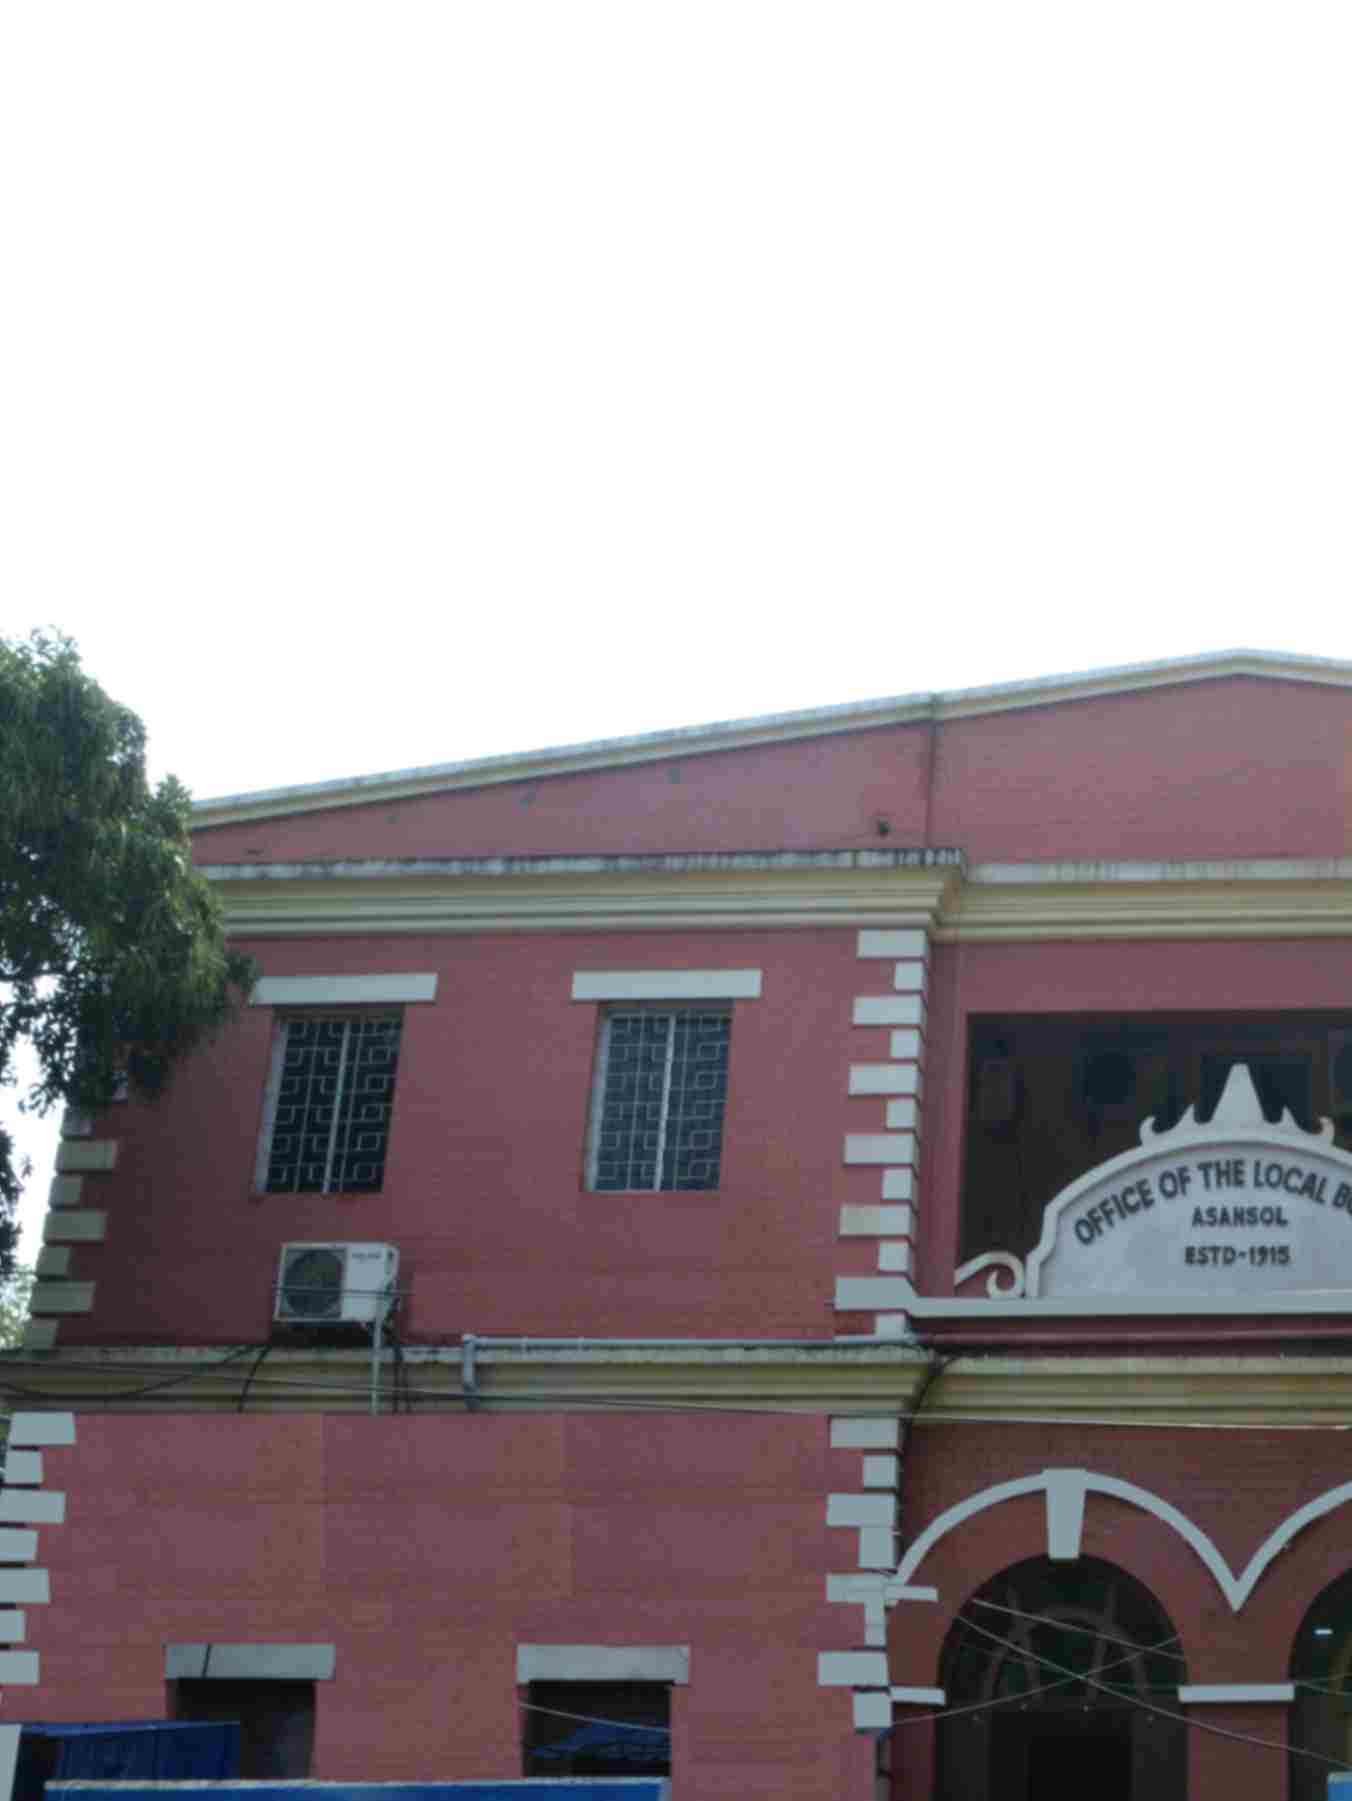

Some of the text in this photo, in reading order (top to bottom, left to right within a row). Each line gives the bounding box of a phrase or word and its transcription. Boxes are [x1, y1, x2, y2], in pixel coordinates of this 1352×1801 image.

[1074, 1179, 1155, 1246] OFFICE
[1158, 1166, 1192, 1199] OF
[1198, 1159, 1246, 1189] THE
[1252, 1160, 1326, 1205] LOCAL
[1192, 1206, 1288, 1228] ASANSOL
